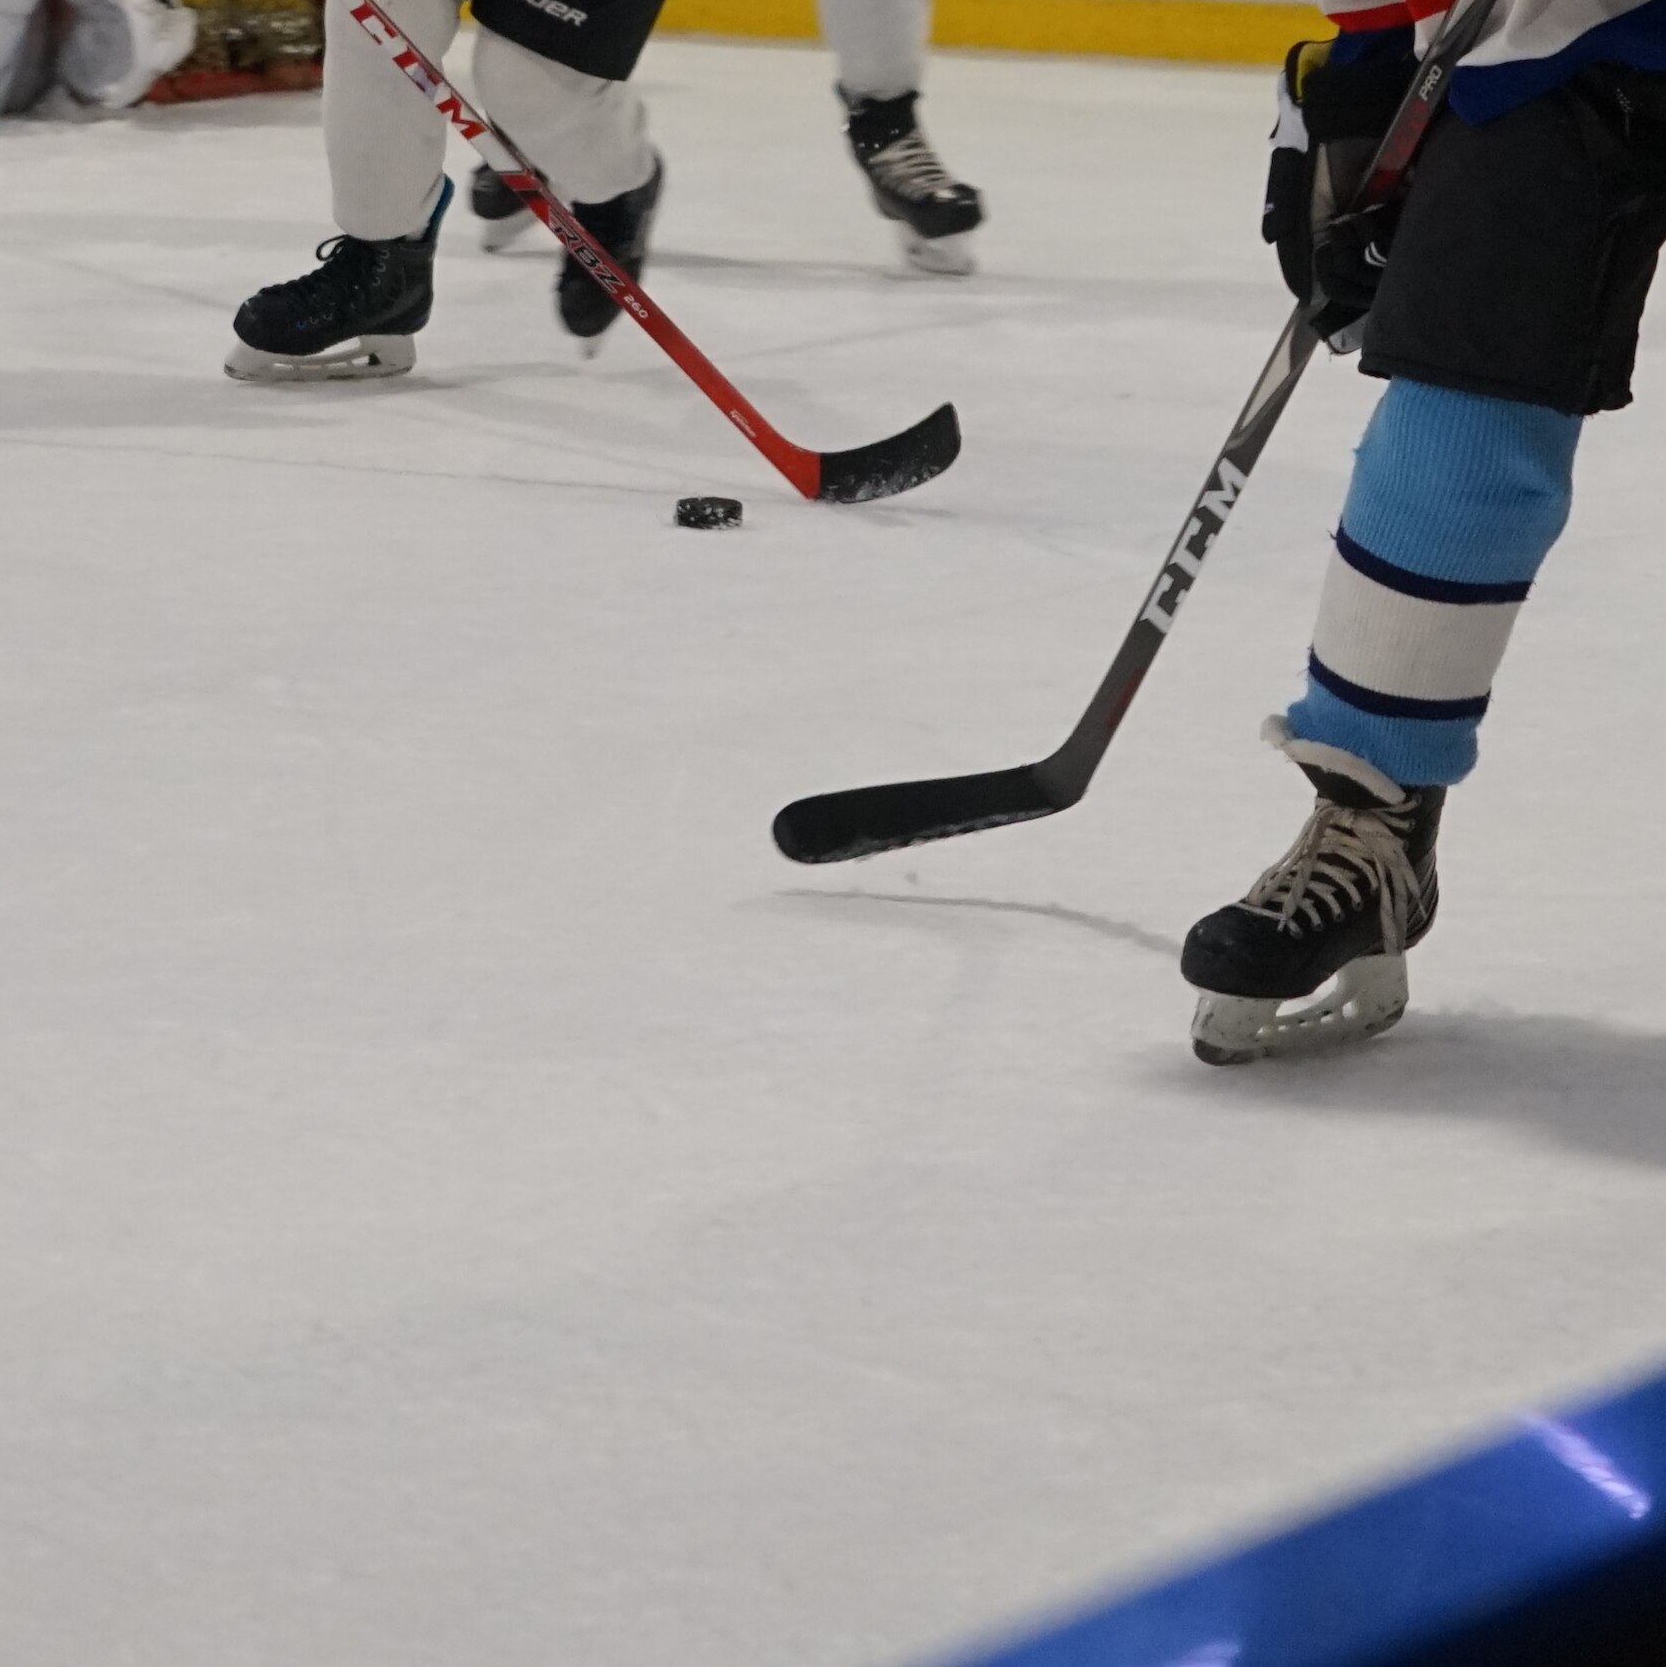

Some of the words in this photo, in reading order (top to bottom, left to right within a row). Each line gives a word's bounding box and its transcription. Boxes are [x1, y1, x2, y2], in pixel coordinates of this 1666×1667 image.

[1418, 64, 1442, 101] PRO
[623, 291, 649, 320] 260
[1139, 456, 1250, 635] CCM
